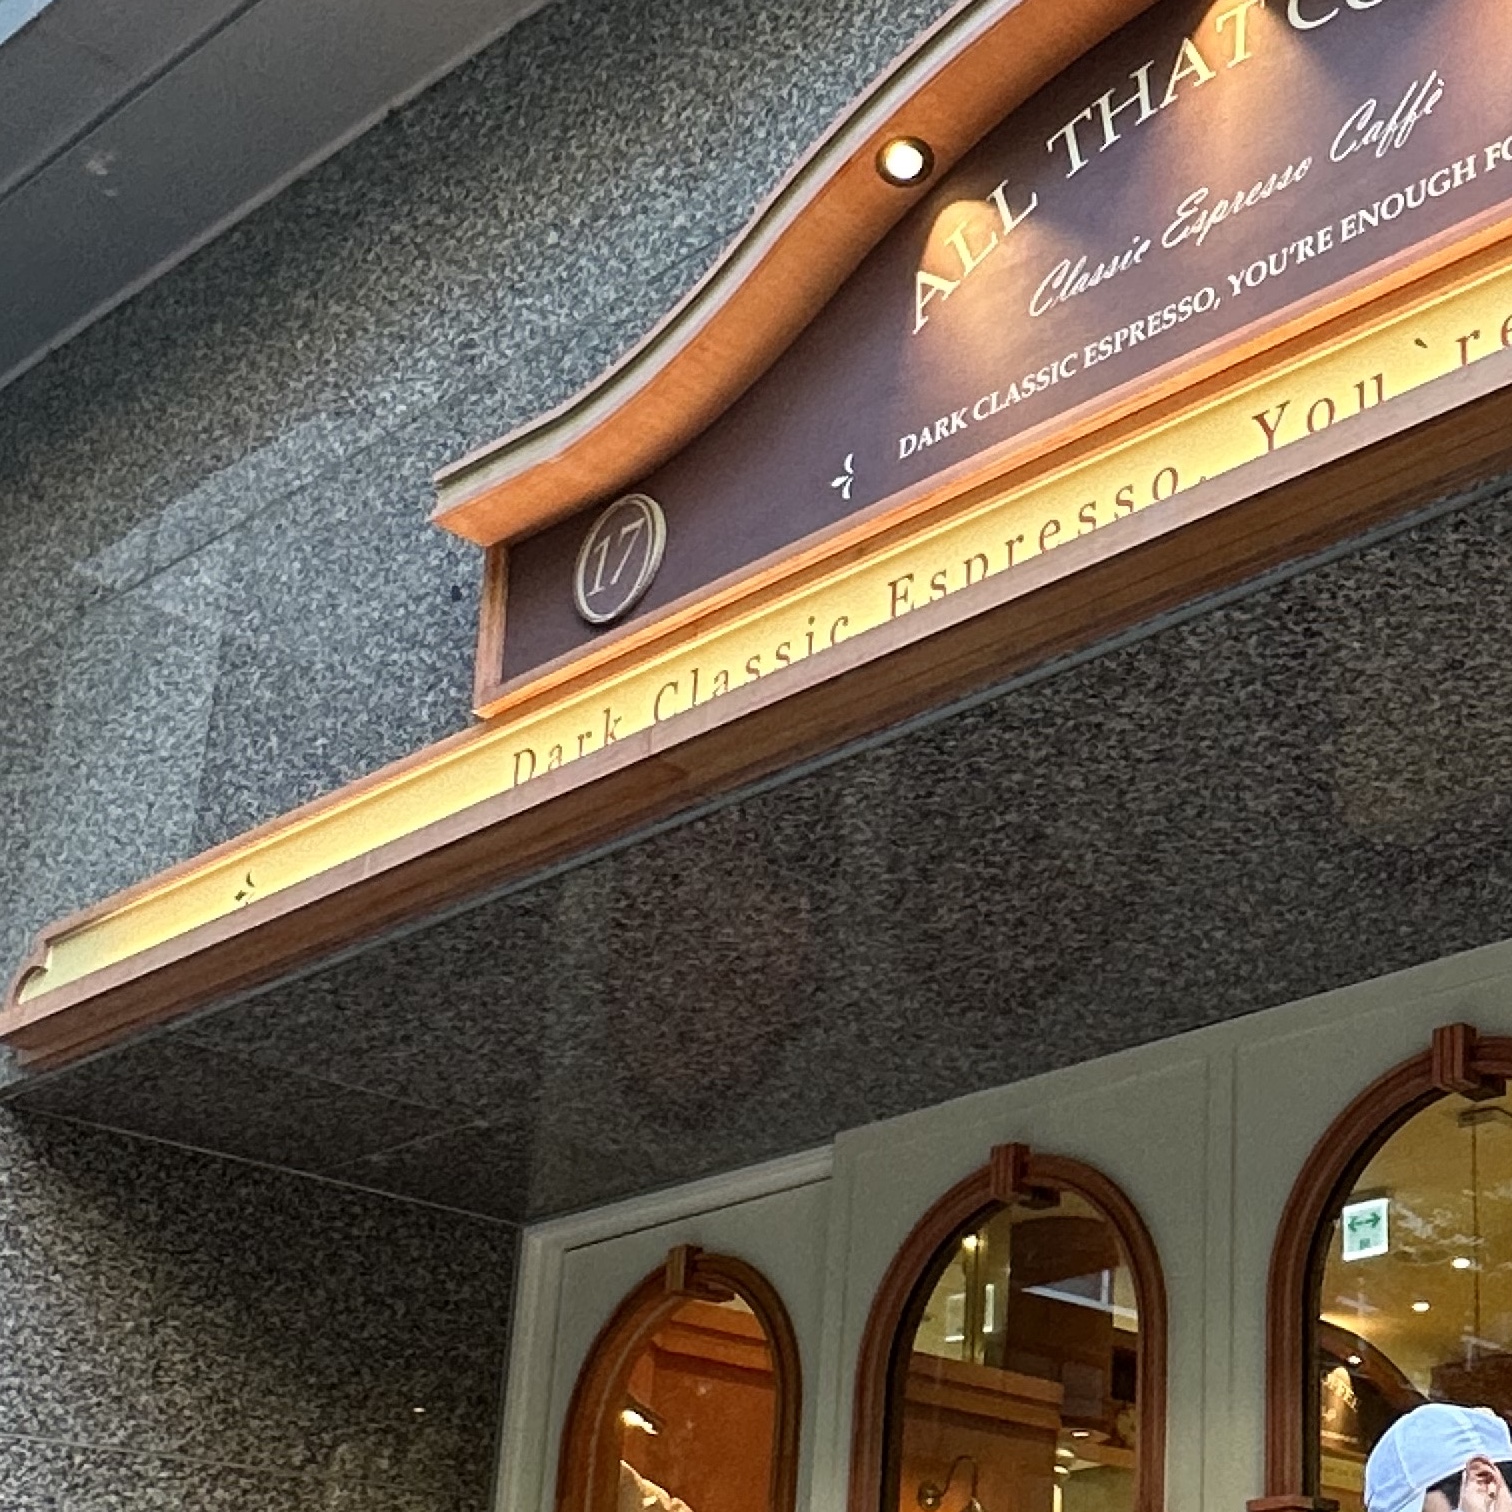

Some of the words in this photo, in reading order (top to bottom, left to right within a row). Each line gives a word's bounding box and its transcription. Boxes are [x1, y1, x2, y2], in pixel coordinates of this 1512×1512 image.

[912, 179, 1038, 335] ALL
[1046, 0, 1265, 179] THAT
[1029, 235, 1151, 318] Classic
[1161, 156, 1313, 249] Espresso
[898, 406, 968, 460] DARK
[972, 351, 1079, 422] CLASSIC
[1082, 285, 1222, 370] ESPRESSO,
[1226, 225, 1334, 297] YOU'RE
[1340, 152, 1478, 244] ENOUGH
[585, 517, 645, 597] 17
[513, 706, 623, 787] Dark
[652, 615, 850, 724] Classic
